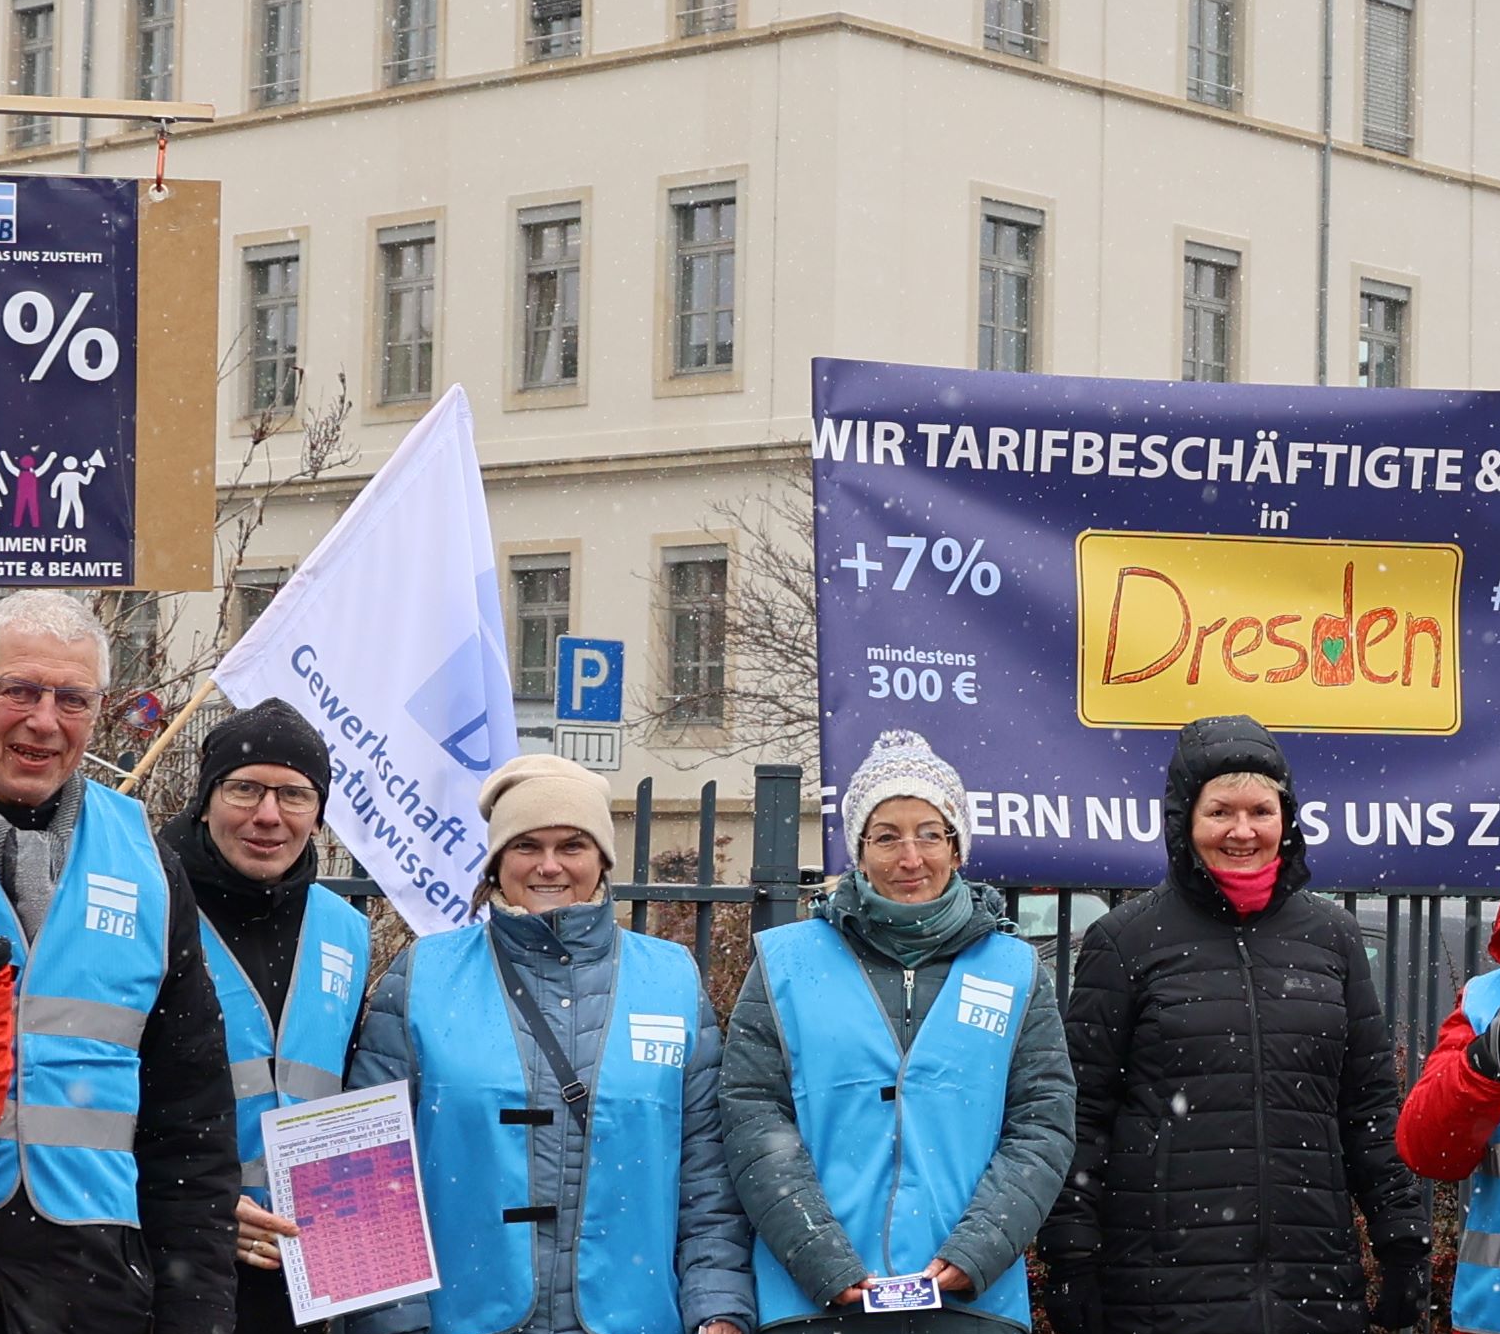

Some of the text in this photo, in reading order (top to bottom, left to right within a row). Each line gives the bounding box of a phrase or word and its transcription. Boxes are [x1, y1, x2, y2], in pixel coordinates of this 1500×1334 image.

[13, 250, 40, 262] UNS
[42, 251, 102, 263] ZUSTEHT!
[811, 417, 905, 466] WIR
[917, 424, 1464, 492] TARIFBESCHÄFTIGTE
[1260, 503, 1289, 530] in
[50, 534, 86, 553] FÜR
[30, 562, 45, 577] &
[48, 561, 122, 577] BEAMTE
[840, 535, 1001, 596] +7%
[1102, 561, 1442, 688] Dresden
[866, 644, 976, 667] mindestens
[572, 648, 609, 710] P
[868, 666, 978, 704] 300 €
[291, 644, 468, 857] Gewerkschaft
[1086, 796, 1160, 842] NU
[1345, 802, 1455, 846] UNS
[97, 908, 135, 937] BTB
[968, 1005, 1007, 1034] BTB
[644, 1042, 684, 1066] BTB
